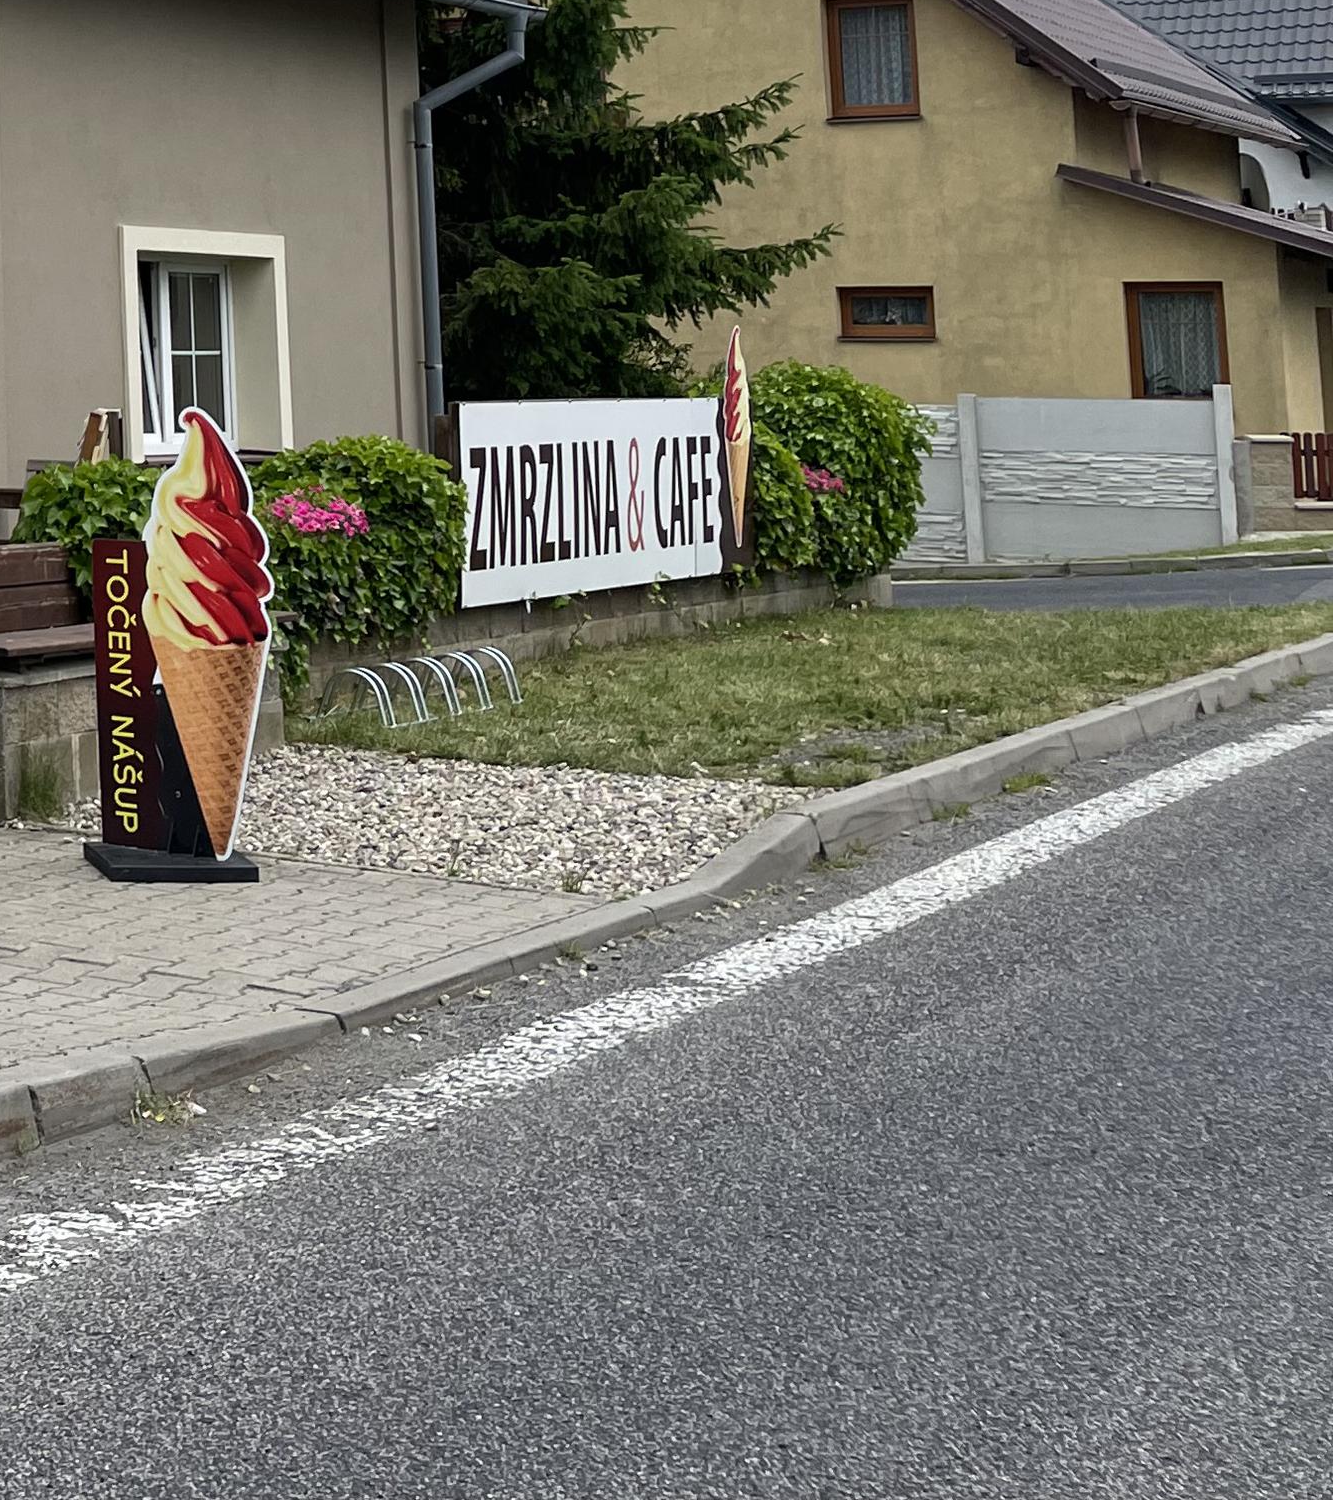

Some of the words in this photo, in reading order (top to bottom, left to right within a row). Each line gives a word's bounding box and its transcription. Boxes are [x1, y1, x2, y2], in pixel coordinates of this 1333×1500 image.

[469, 439, 622, 572] ZMRZLINA
[627, 437, 645, 553] &
[654, 436, 715, 549] CAFE
[104, 548, 141, 698] TOČENÝ
[110, 715, 145, 834] NÁŠUP
